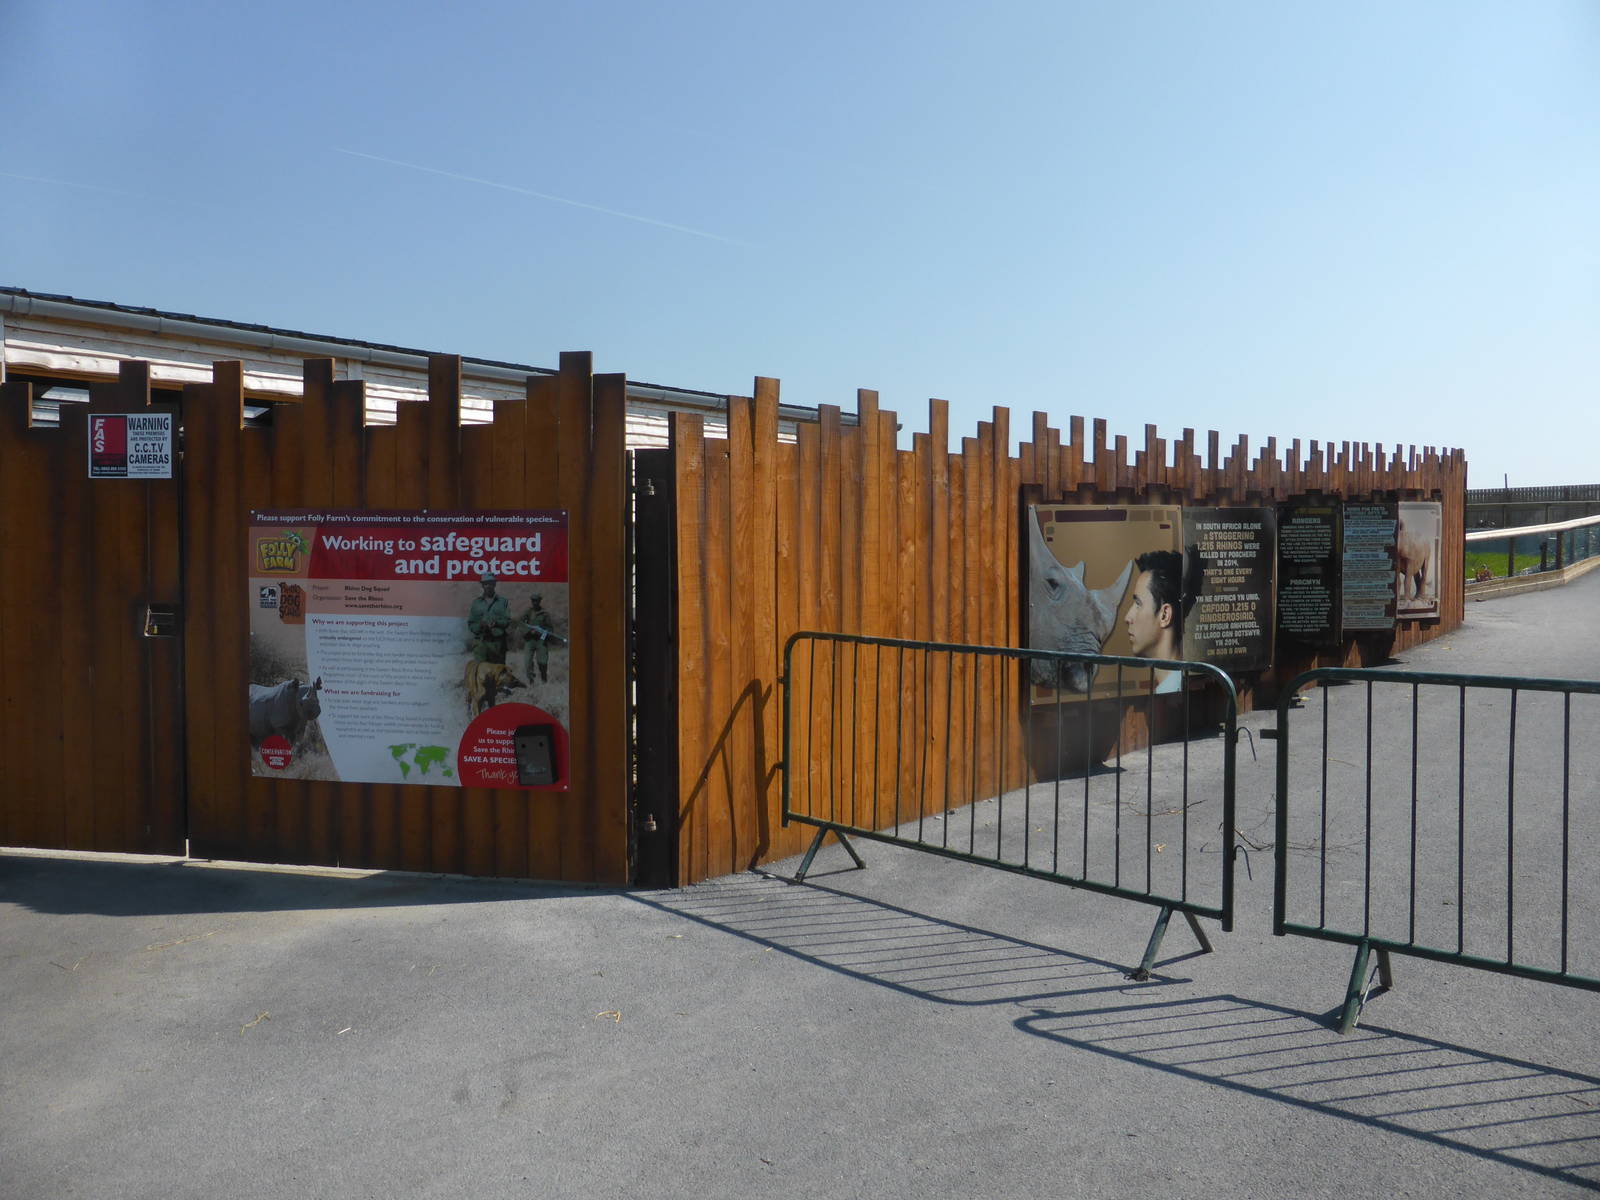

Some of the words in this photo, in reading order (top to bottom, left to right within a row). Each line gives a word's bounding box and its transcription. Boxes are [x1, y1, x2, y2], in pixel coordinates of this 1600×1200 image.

[128, 418, 169, 430] WARNING
[129, 454, 169, 464] CAMERAS
[280, 515, 306, 523] support
[308, 514, 324, 523] Folly
[1209, 531, 1255, 540] STAGGERING
[260, 542, 298, 556] FOLLY
[322, 536, 394, 554] Working
[399, 539, 416, 551] to
[420, 532, 541, 557] safeguard
[1216, 541, 1242, 550] RHINOS
[263, 556, 295, 570] FARM
[394, 555, 440, 574] and
[446, 557, 540, 580] protect
[486, 728, 507, 736] Please
[475, 768, 507, 780] Thank
